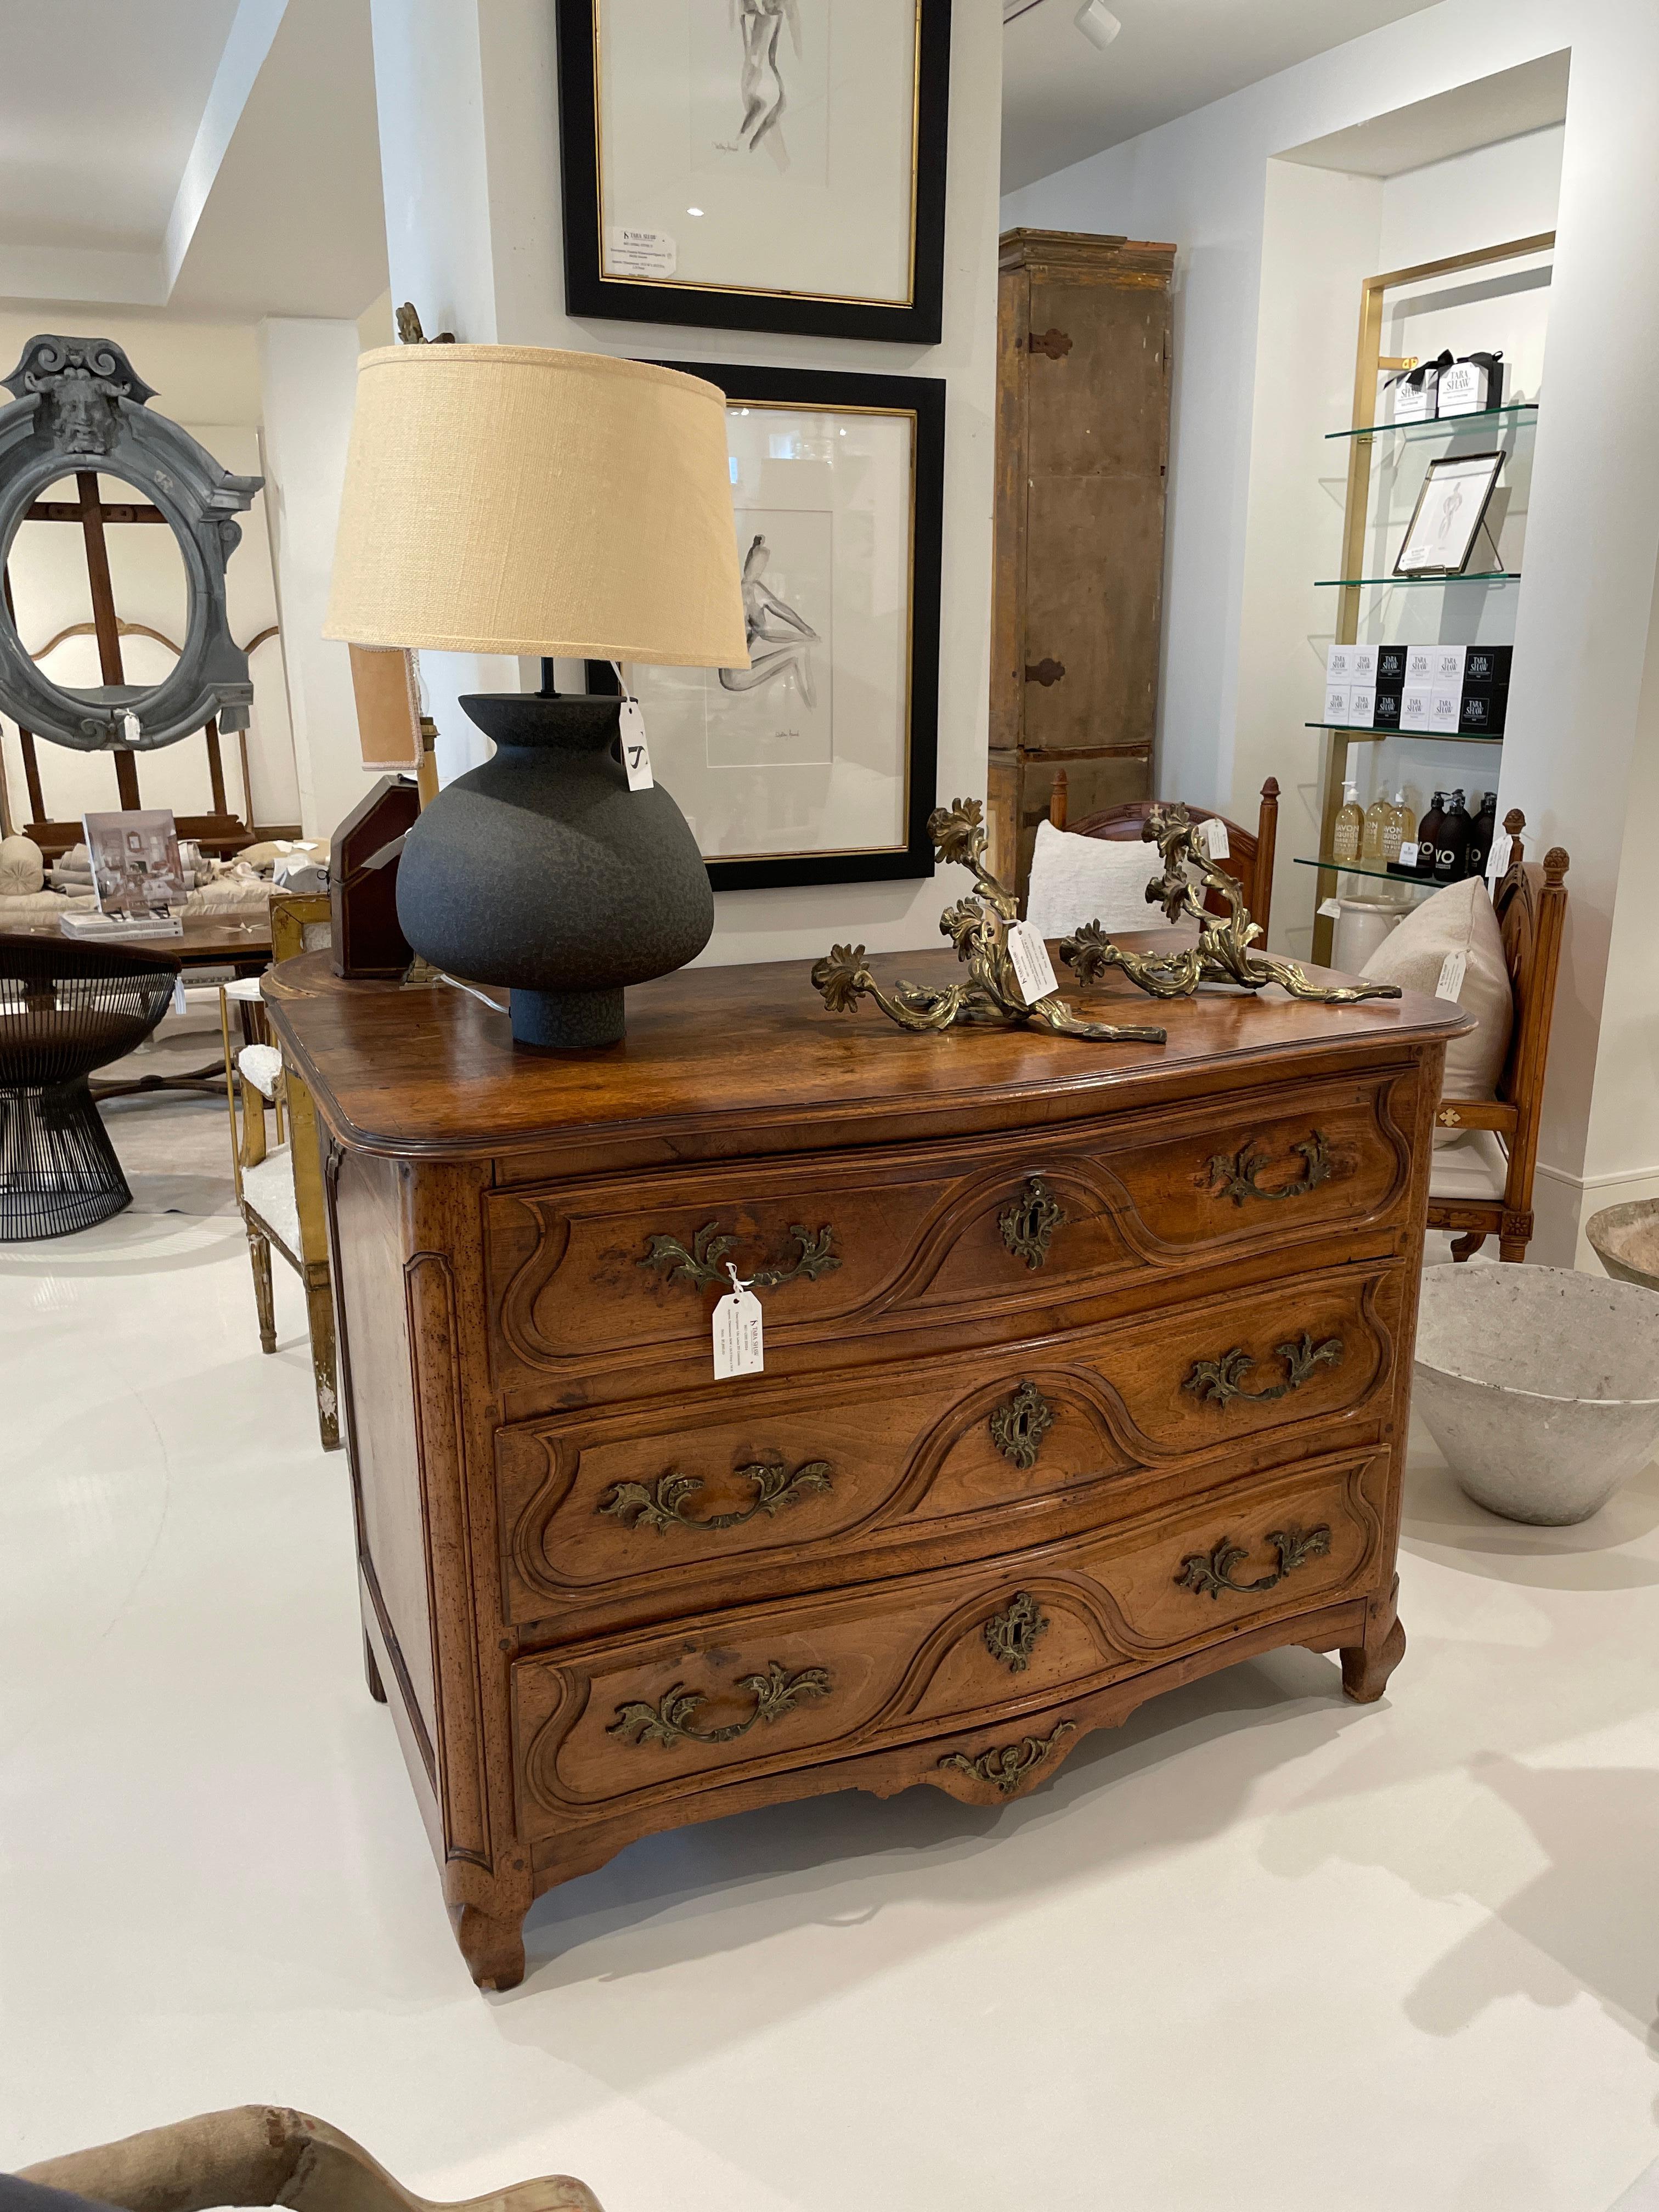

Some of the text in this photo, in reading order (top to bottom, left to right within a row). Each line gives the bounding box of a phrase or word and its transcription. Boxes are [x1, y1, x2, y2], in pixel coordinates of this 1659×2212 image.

[1451, 370, 1469, 379] TARA
[1447, 378, 1469, 391] SHAW
[1470, 663, 1488, 672] SHAW
[1466, 707, 1483, 715] SHAW
